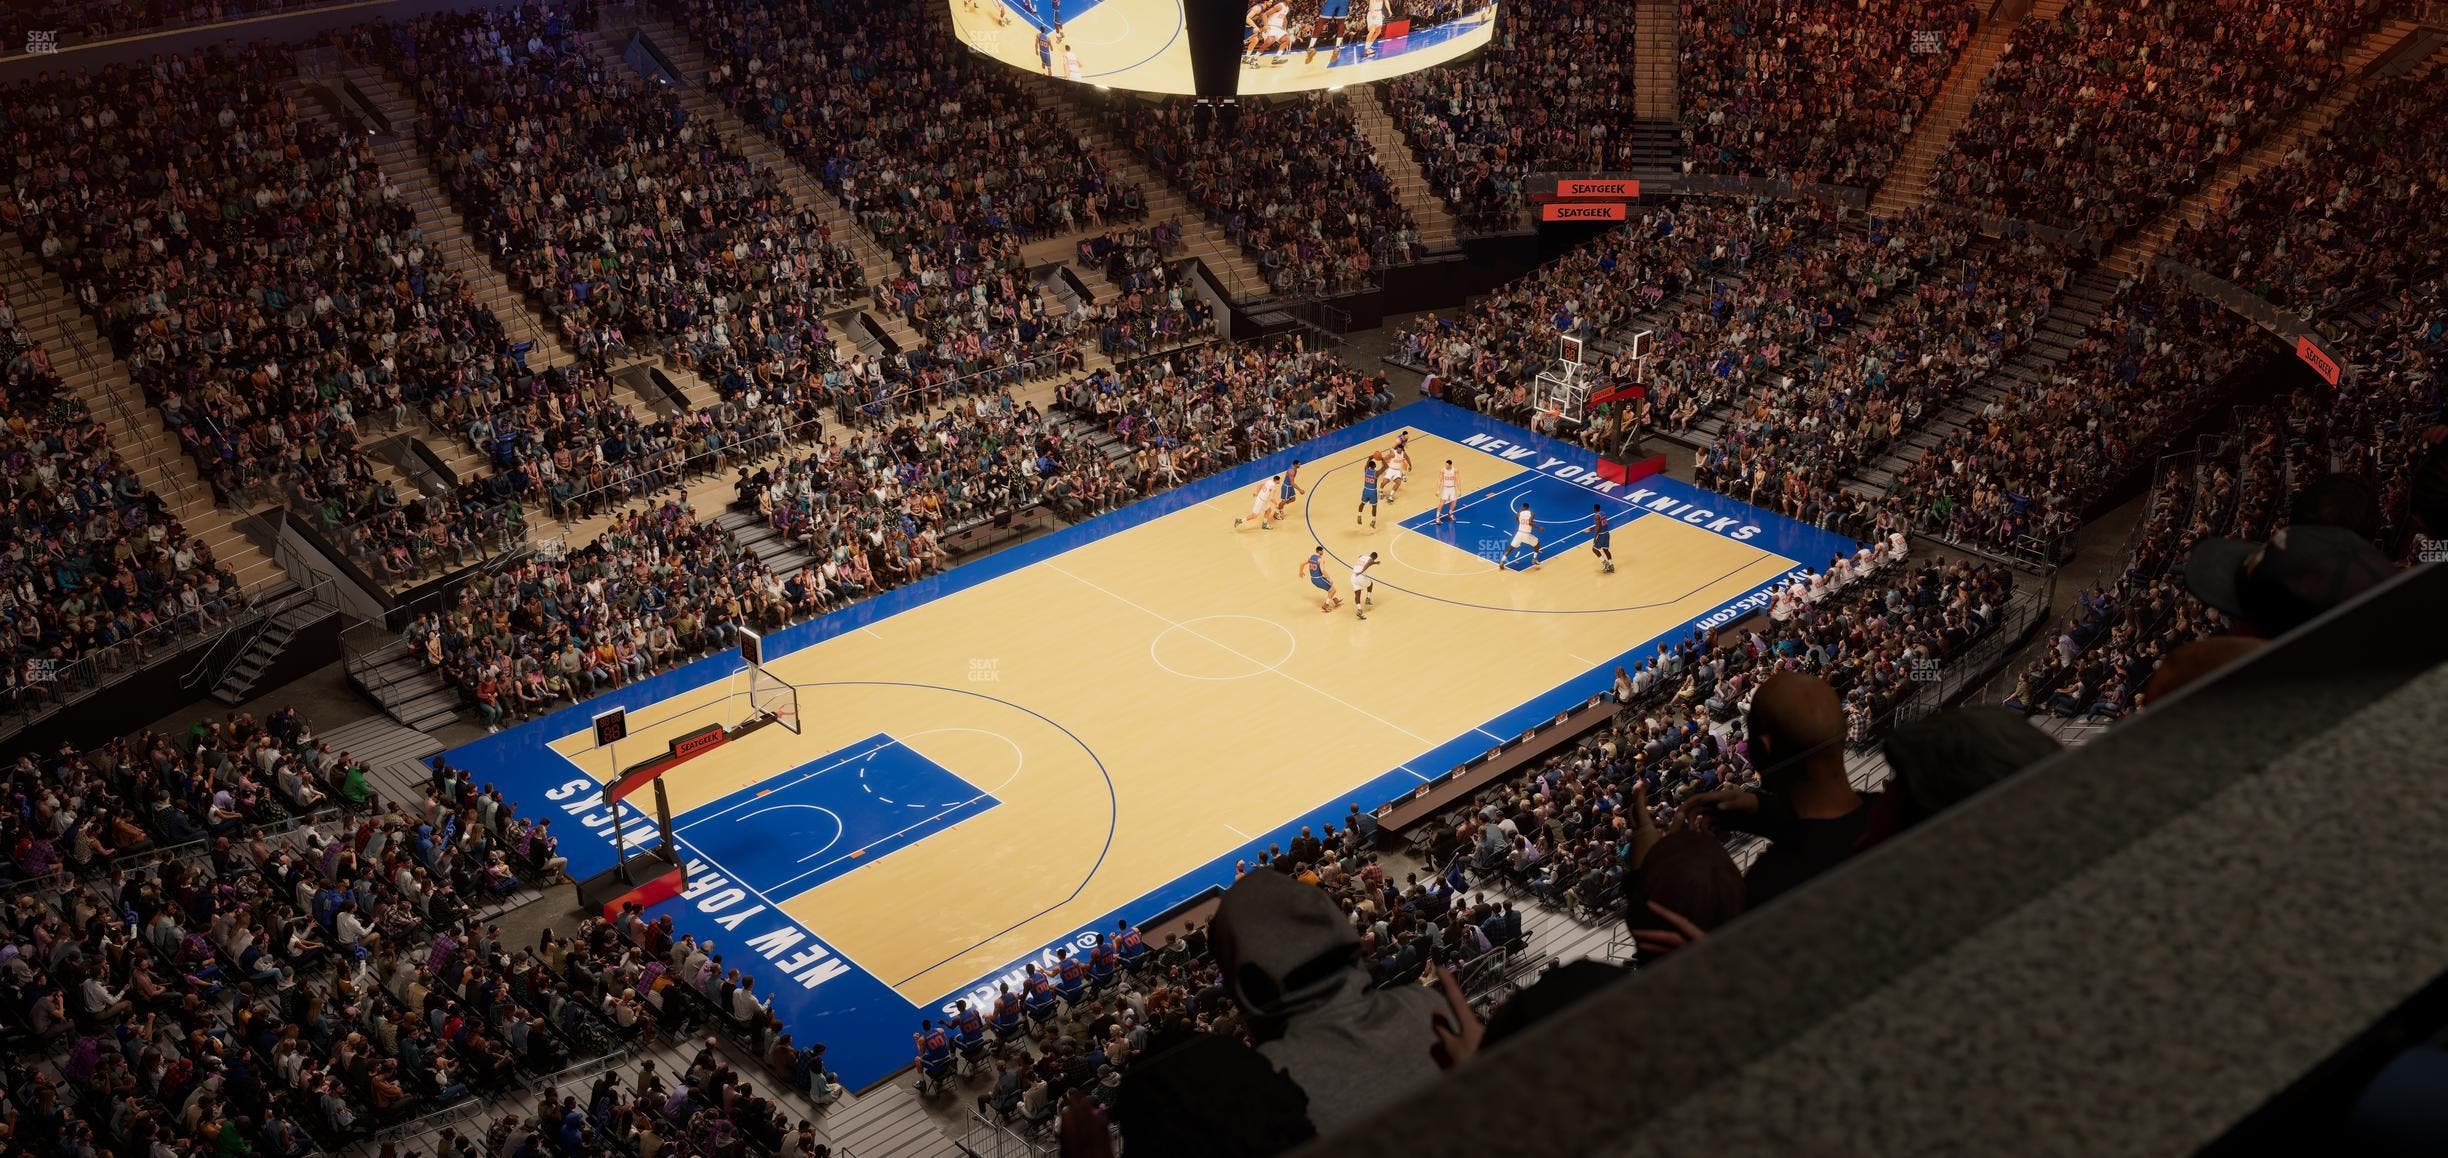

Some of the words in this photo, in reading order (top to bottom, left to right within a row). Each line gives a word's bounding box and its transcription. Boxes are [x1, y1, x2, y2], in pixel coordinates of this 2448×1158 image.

[1572, 184, 1625, 194] SEATGEEK
[1557, 208, 1612, 218] SEATGEEK
[1461, 433, 1537, 460] NEW
[1536, 457, 1621, 493] YORK
[1623, 488, 1761, 540] KNICKS
[1696, 569, 1809, 630] nykicks.com
[681, 731, 719, 753] SEATGEEK
[545, 779, 682, 858] NICKS
[1124, 933, 1140, 948] 00
[745, 926, 851, 989] NEW
[927, 1035, 945, 1050] 00
